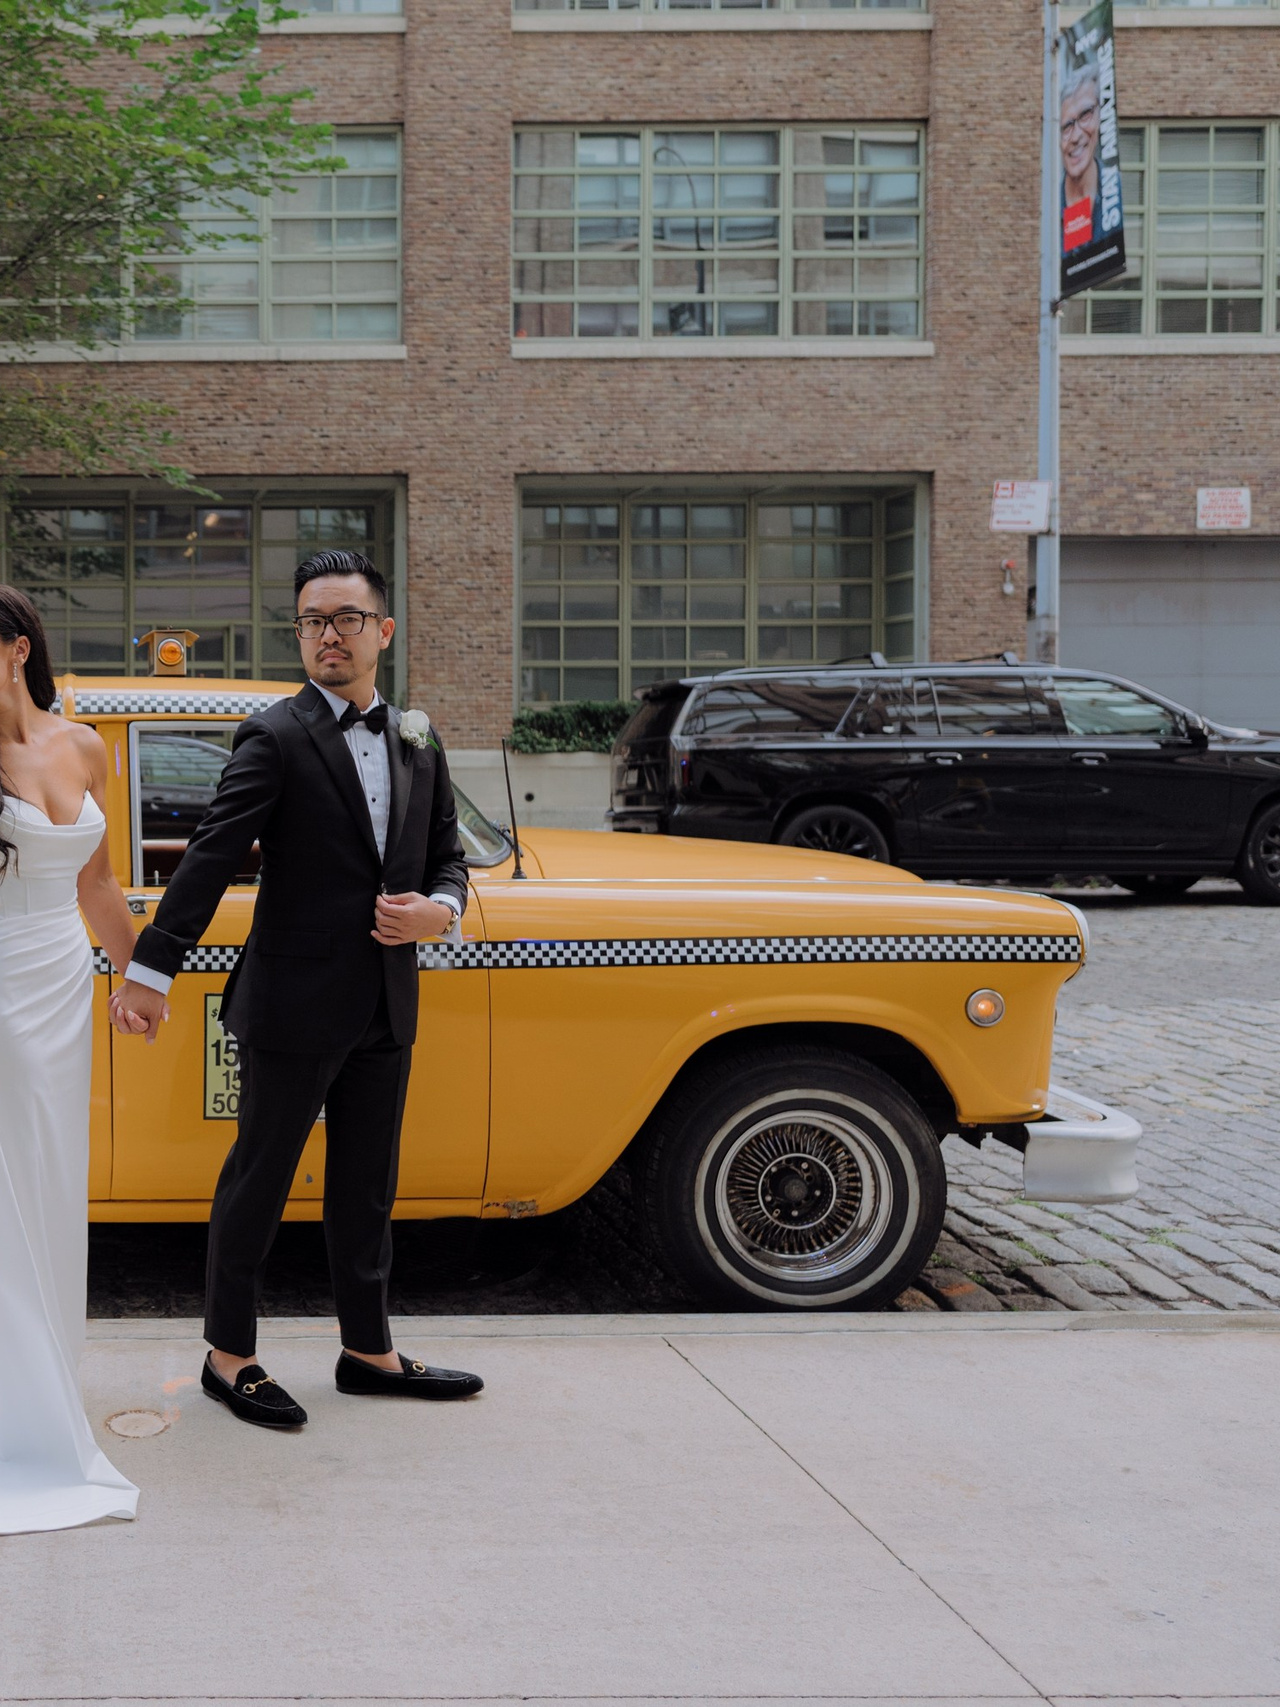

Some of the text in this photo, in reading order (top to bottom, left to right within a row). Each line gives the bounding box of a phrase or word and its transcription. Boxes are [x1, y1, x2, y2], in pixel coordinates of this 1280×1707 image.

[1098, 38, 1121, 232] STAY AMAZING
[211, 1039, 240, 1067] 15
